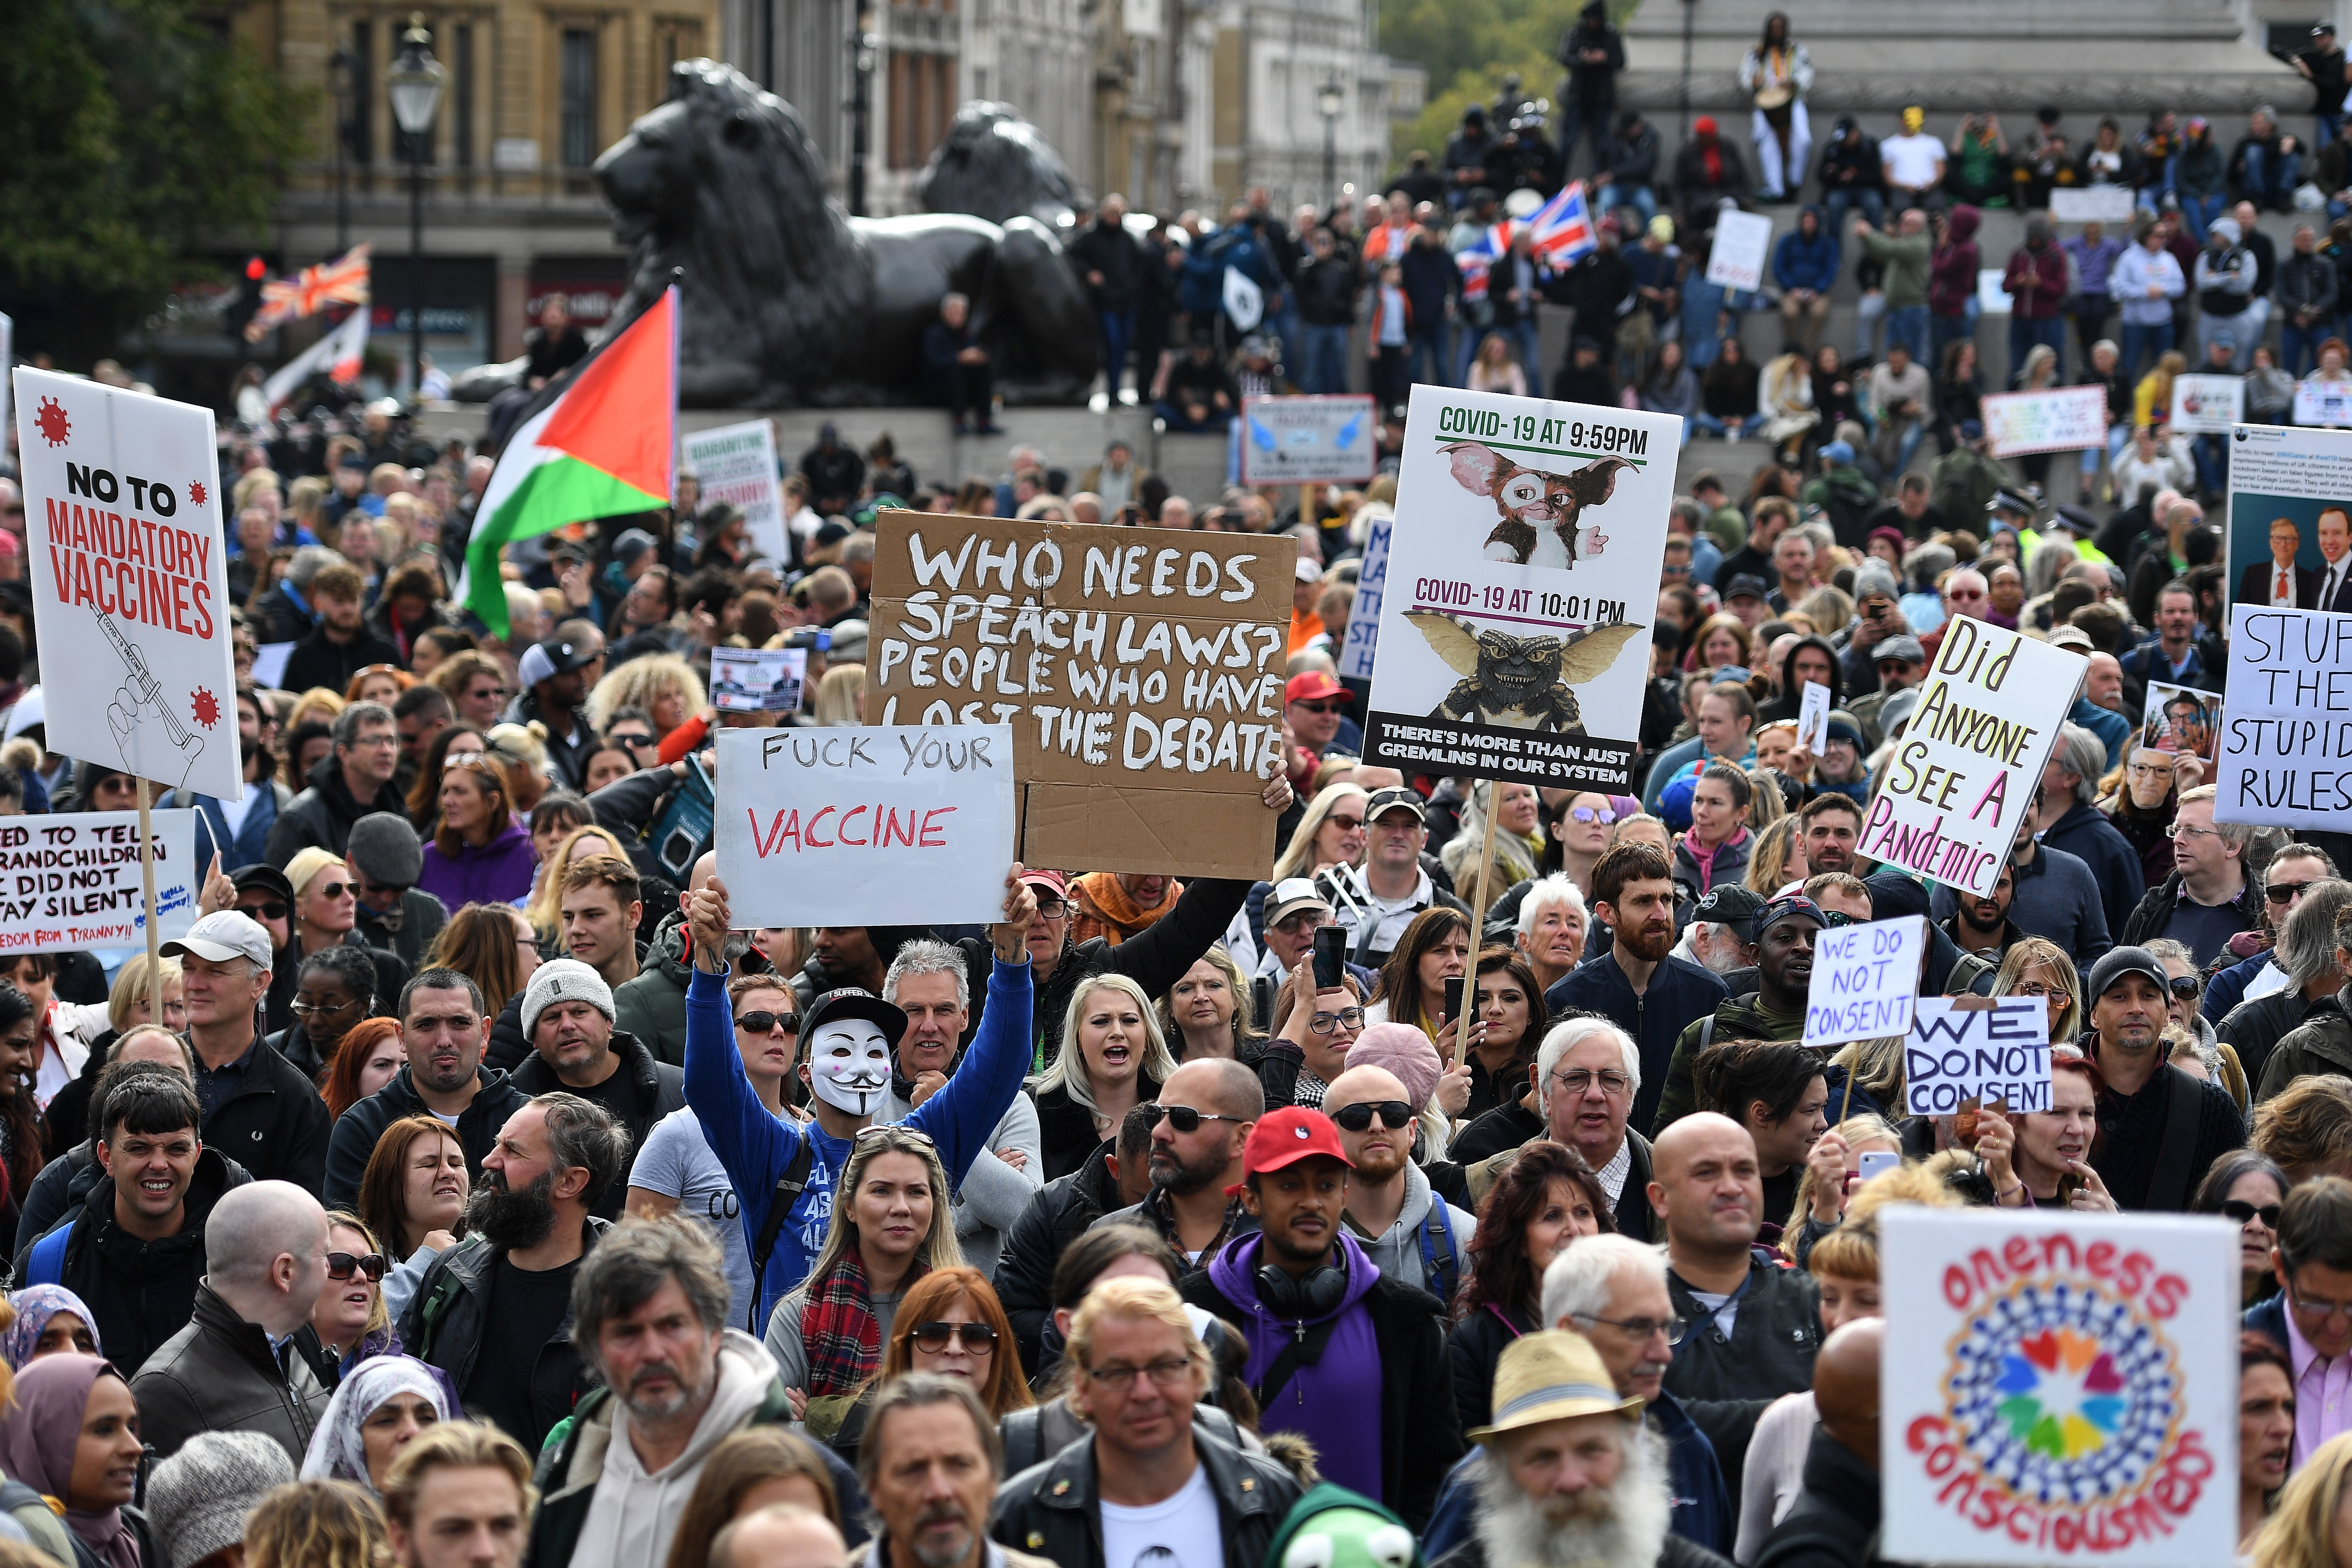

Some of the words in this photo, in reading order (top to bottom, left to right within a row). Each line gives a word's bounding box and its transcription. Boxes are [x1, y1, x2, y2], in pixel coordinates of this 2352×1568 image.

[1440, 406, 1535, 441] COVID-19
[1539, 418, 1567, 445] AT
[1570, 422, 1648, 455] 9:59PM
[66, 461, 118, 503] NO
[126, 474, 177, 517] TO
[46, 497, 209, 581] MANDATORY
[908, 529, 1063, 591] WHO
[1083, 544, 1257, 603] NEEDS
[49, 545, 213, 639] VACCINES
[1415, 577, 1504, 611] COVID-19
[1508, 588, 1533, 613] AT
[1539, 593, 1590, 620] 10:01
[1596, 599, 1626, 622] PM
[103, 618, 123, 647] COVID-19
[123, 647, 142, 673] VACCINE
[898, 590, 1108, 663] SPEACH
[1116, 614, 1281, 674] LAWS?
[2244, 613, 2352, 664] STUF
[879, 637, 1056, 695] PEOPLE
[1068, 659, 1168, 706] WHO
[1183, 667, 1286, 718] HAVE
[2259, 669, 2352, 711] THE
[1032, 704, 1116, 766] THE
[1122, 710, 1281, 780] DEBATE
[1381, 722, 1458, 745] THERE'S
[1461, 733, 1519, 754] MORE
[1524, 740, 1580, 760] THAN
[1583, 747, 1630, 766] JUST
[1911, 681, 2038, 769] ANYONE
[2227, 718, 2352, 759] STUPID
[763, 732, 877, 770] FUCK
[899, 731, 993, 776] YOUR
[1378, 742, 1478, 767] GREMLINS
[1480, 753, 1499, 769] IN
[1502, 756, 1545, 774] OUR
[1549, 761, 1627, 784] SYSTEM
[1968, 770, 2008, 828] A
[2240, 768, 2352, 812] RULES
[40, 826, 76, 845] TO
[748, 803, 957, 859] VACCINE
[0, 844, 166, 869] RANDCHILDRN
[16, 873, 63, 897] DID
[69, 868, 120, 889] NOT
[45, 888, 139, 917] SILENT
[34, 929, 61, 946] FROM
[67, 924, 132, 944] TYRANNY!!
[1823, 932, 1859, 961] WE
[1873, 929, 1902, 955] DO
[1831, 959, 1892, 994] NOT
[1806, 995, 1911, 1040] CONSENT
[1916, 1004, 2038, 1045] WE
[1911, 1079, 2053, 1113] CONSENT
[708, 1189, 740, 1221] CO
